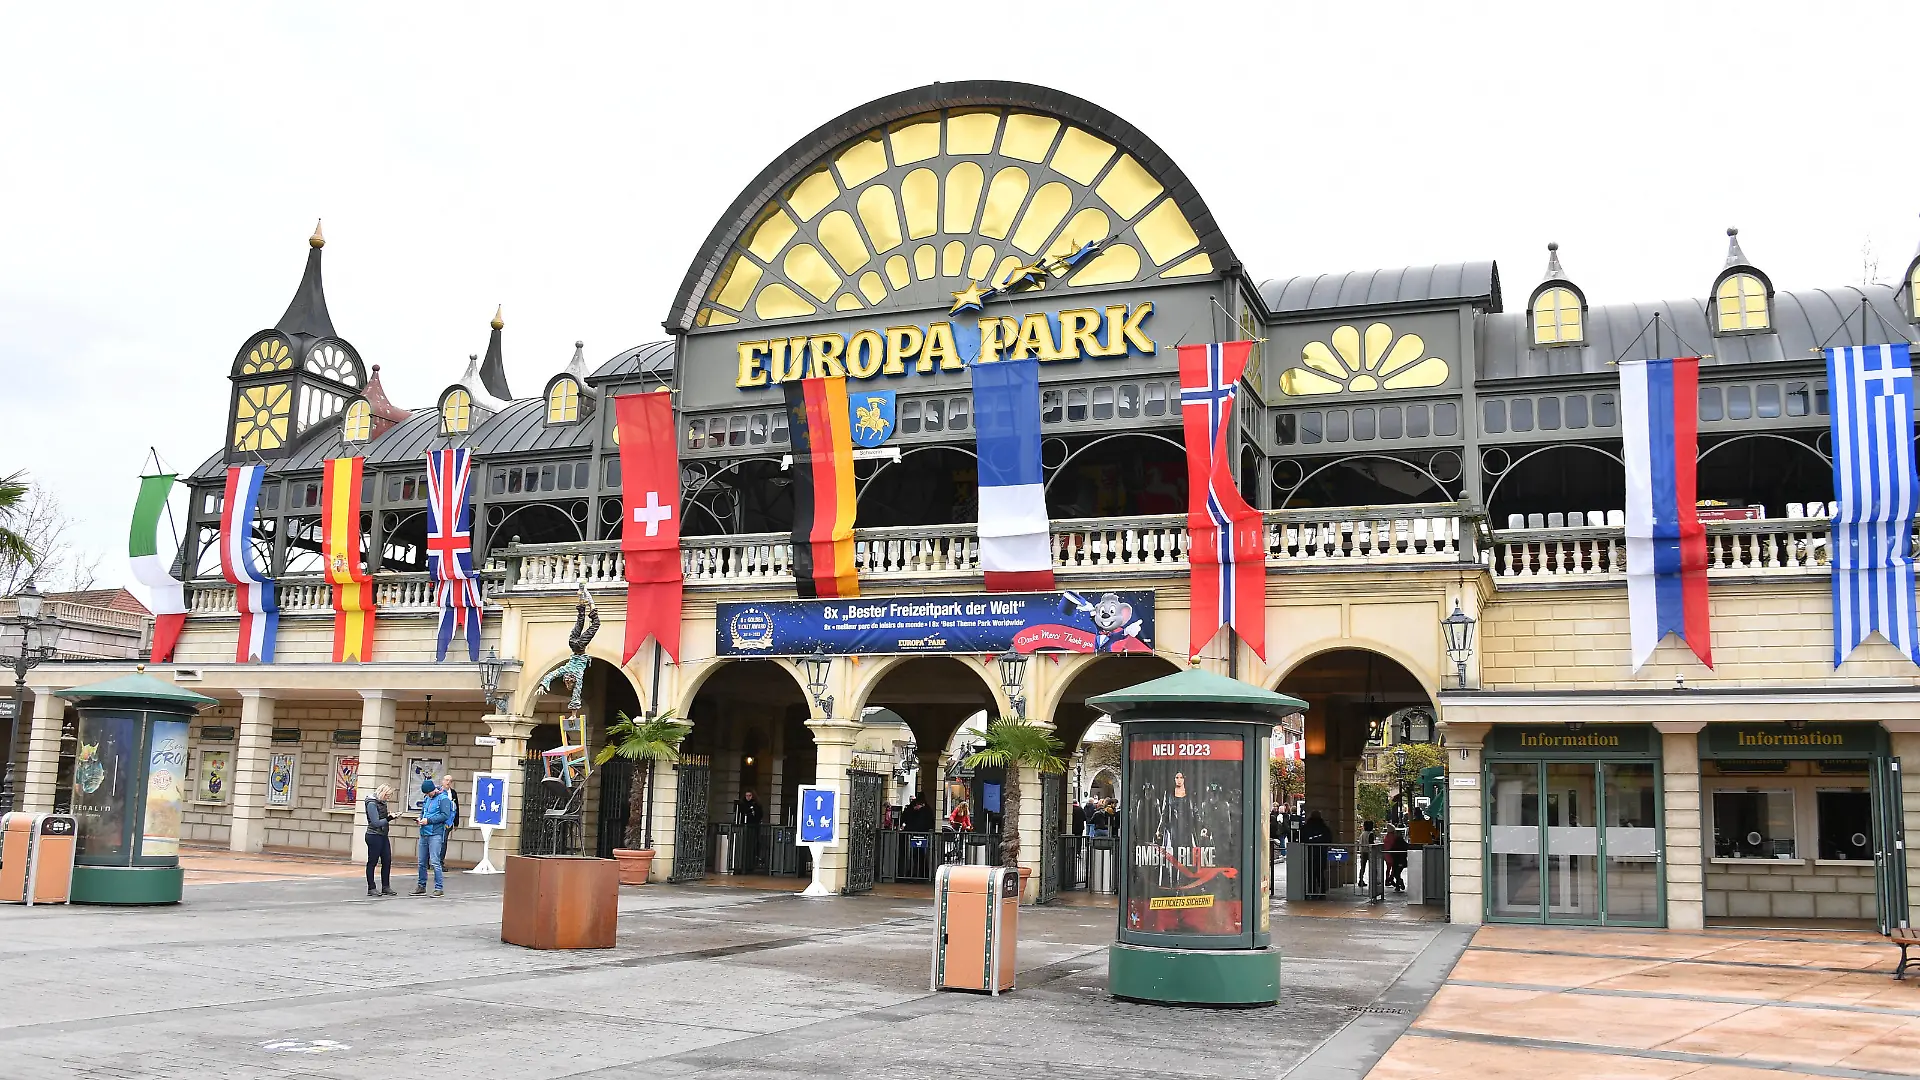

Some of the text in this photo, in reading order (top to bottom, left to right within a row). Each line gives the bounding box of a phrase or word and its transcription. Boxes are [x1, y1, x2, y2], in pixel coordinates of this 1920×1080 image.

[736, 302, 1157, 389] EUROPA PARK
[823, 606, 838, 619] 8x
[890, 602, 962, 618] Freizeitpark
[966, 602, 986, 615] der
[1017, 634, 1039, 646] Danke
[1064, 632, 1082, 645] Thank
[1520, 732, 1619, 747] Information
[1738, 731, 1843, 746] Information
[1152, 743, 1210, 756] NEU 2023
[1135, 845, 1215, 868] AMBER BLAKE
[1151, 897, 1211, 908] JETZT TICKETS SICHERN!
